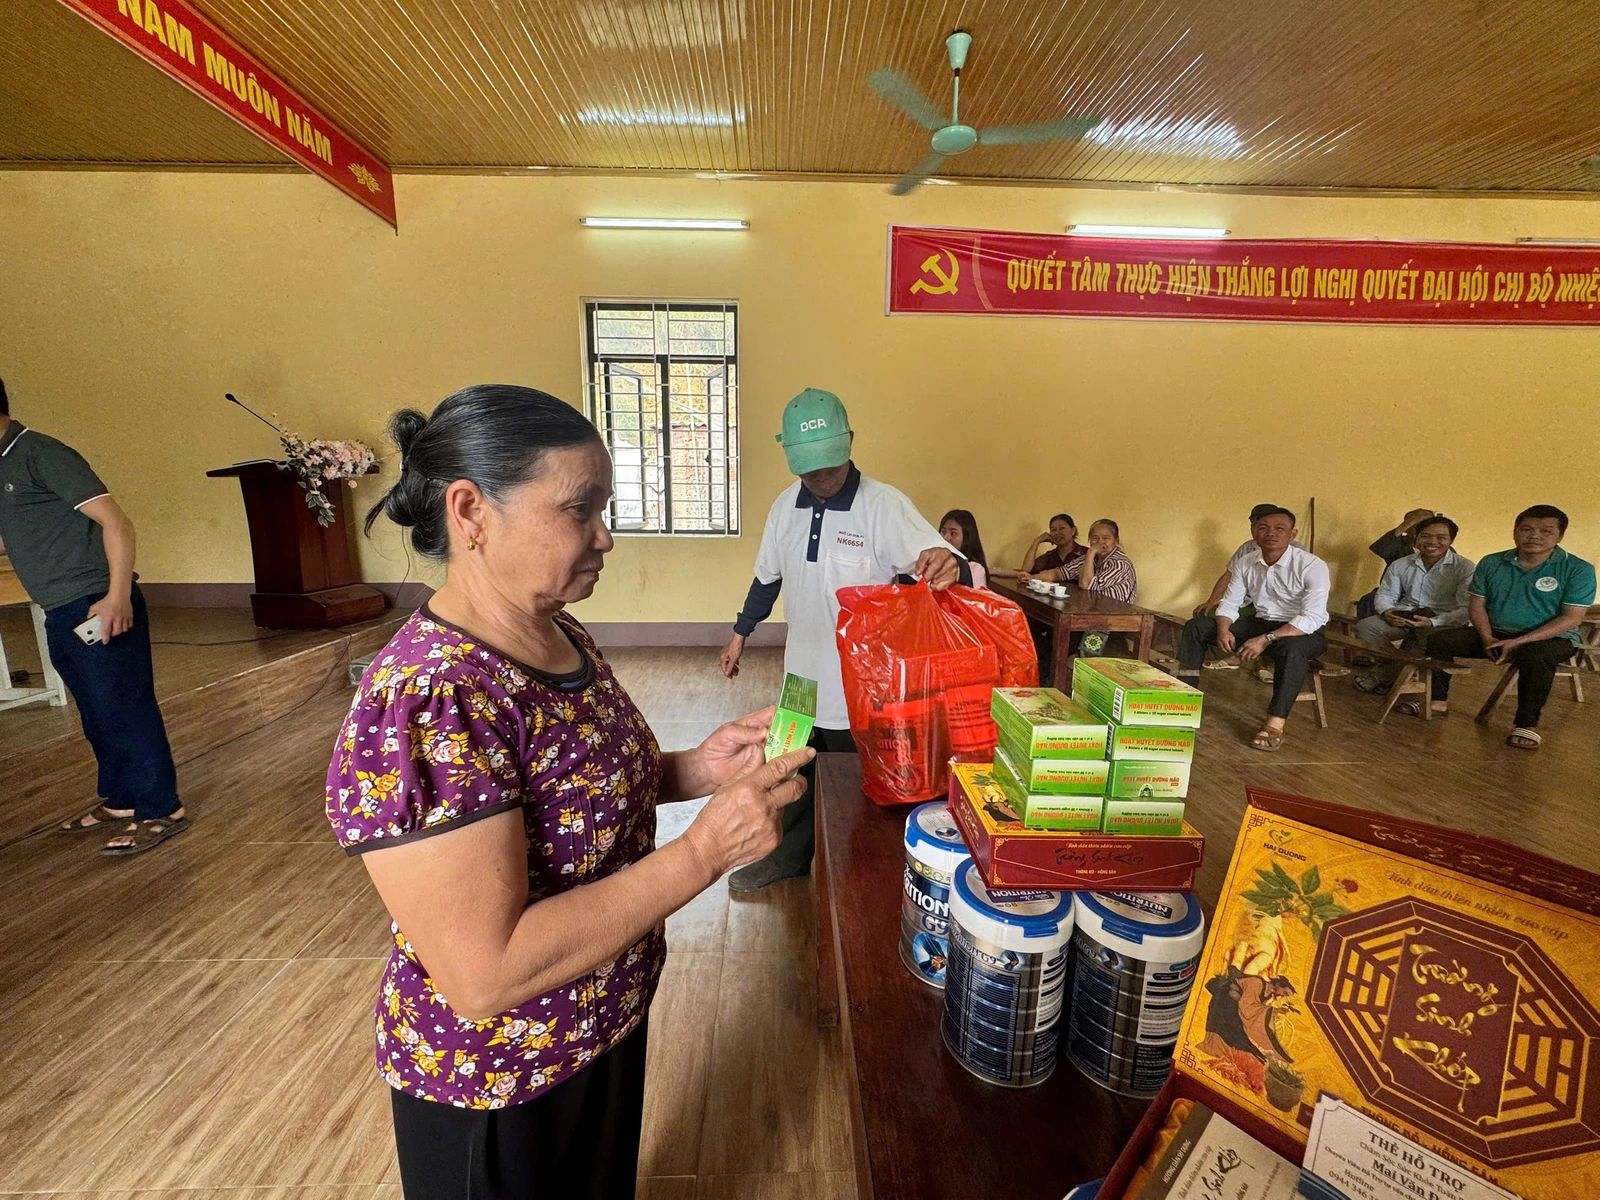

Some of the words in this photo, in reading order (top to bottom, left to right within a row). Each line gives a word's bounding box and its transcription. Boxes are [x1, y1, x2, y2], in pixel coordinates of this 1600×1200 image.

[203, 41, 281, 129] MUÔN
[285, 106, 333, 166] NĂM
[1006, 250, 1065, 294] QUYẾT
[1071, 256, 1110, 293] TÂM
[1115, 261, 1163, 300] THỰC
[1165, 258, 1212, 302] HIỆN
[1215, 255, 1275, 298] THẮNG
[1280, 265, 1309, 305] LỢI
[1313, 267, 1358, 307] NGHỊ
[1362, 259, 1419, 303] QUYẾT
[1422, 270, 1453, 308] ĐẠI
[1457, 264, 1490, 309] HỘI
[1525, 266, 1555, 309] BỘ
[1555, 267, 1600, 310] NHIỆ
[836, 537, 864, 548] NK6654
[1263, 842, 1277, 851] HAI
[1278, 847, 1307, 862] DUONG
[903, 874, 949, 917] RITION
[1110, 891, 1168, 913] NUTRITIO
[1409, 944, 1501, 1016] Trường
[1415, 992, 1475, 1038] Sinh
[1392, 1031, 1481, 1113] Khớp
[1359, 1141, 1381, 1158] Chăm
[1368, 1131, 1399, 1157] THẺ
[1402, 1150, 1426, 1170] HỖ
[1429, 1164, 1466, 1192] TRỢ
[1328, 1170, 1349, 1188] 0944
[1351, 1183, 1368, 1198] 346
[1344, 1169, 1375, 1192] Hotline
[1372, 1159, 1397, 1180] Mai
[1400, 1173, 1425, 1197] Văn
